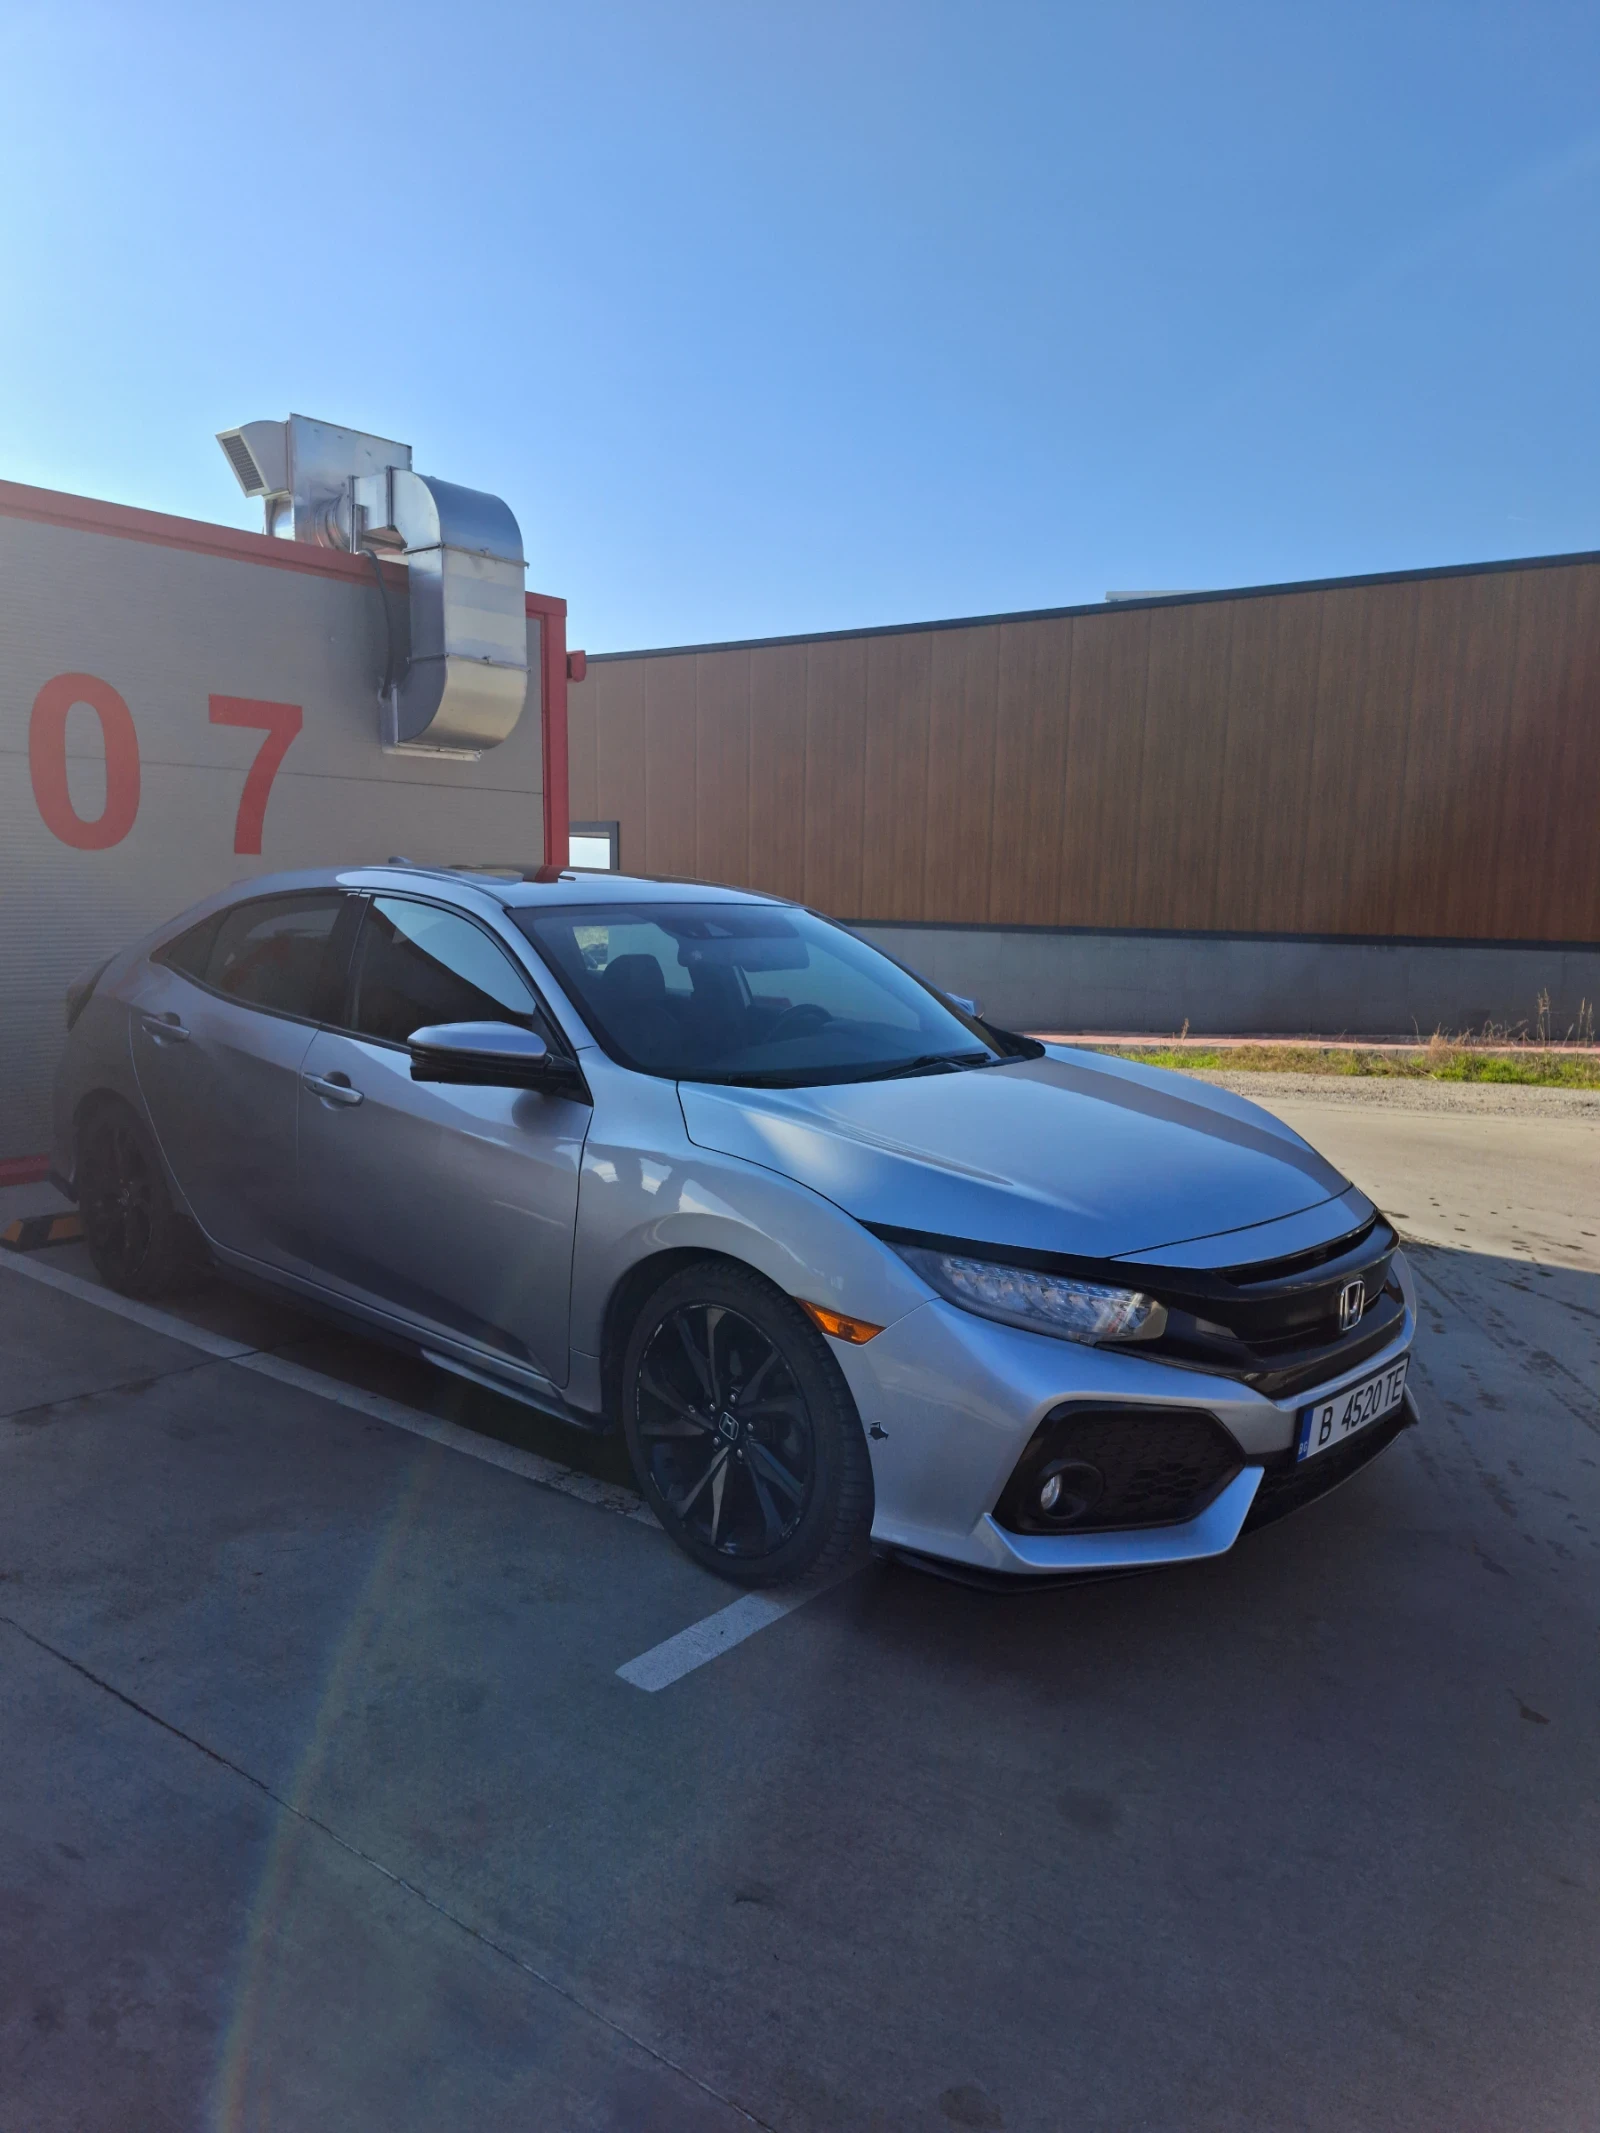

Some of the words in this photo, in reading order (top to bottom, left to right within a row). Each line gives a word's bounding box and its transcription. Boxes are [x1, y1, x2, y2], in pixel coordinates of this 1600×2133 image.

[1318, 1405, 1333, 1447] B
[1341, 1379, 1383, 1432] 4520
[1384, 1364, 1405, 1408] TE
